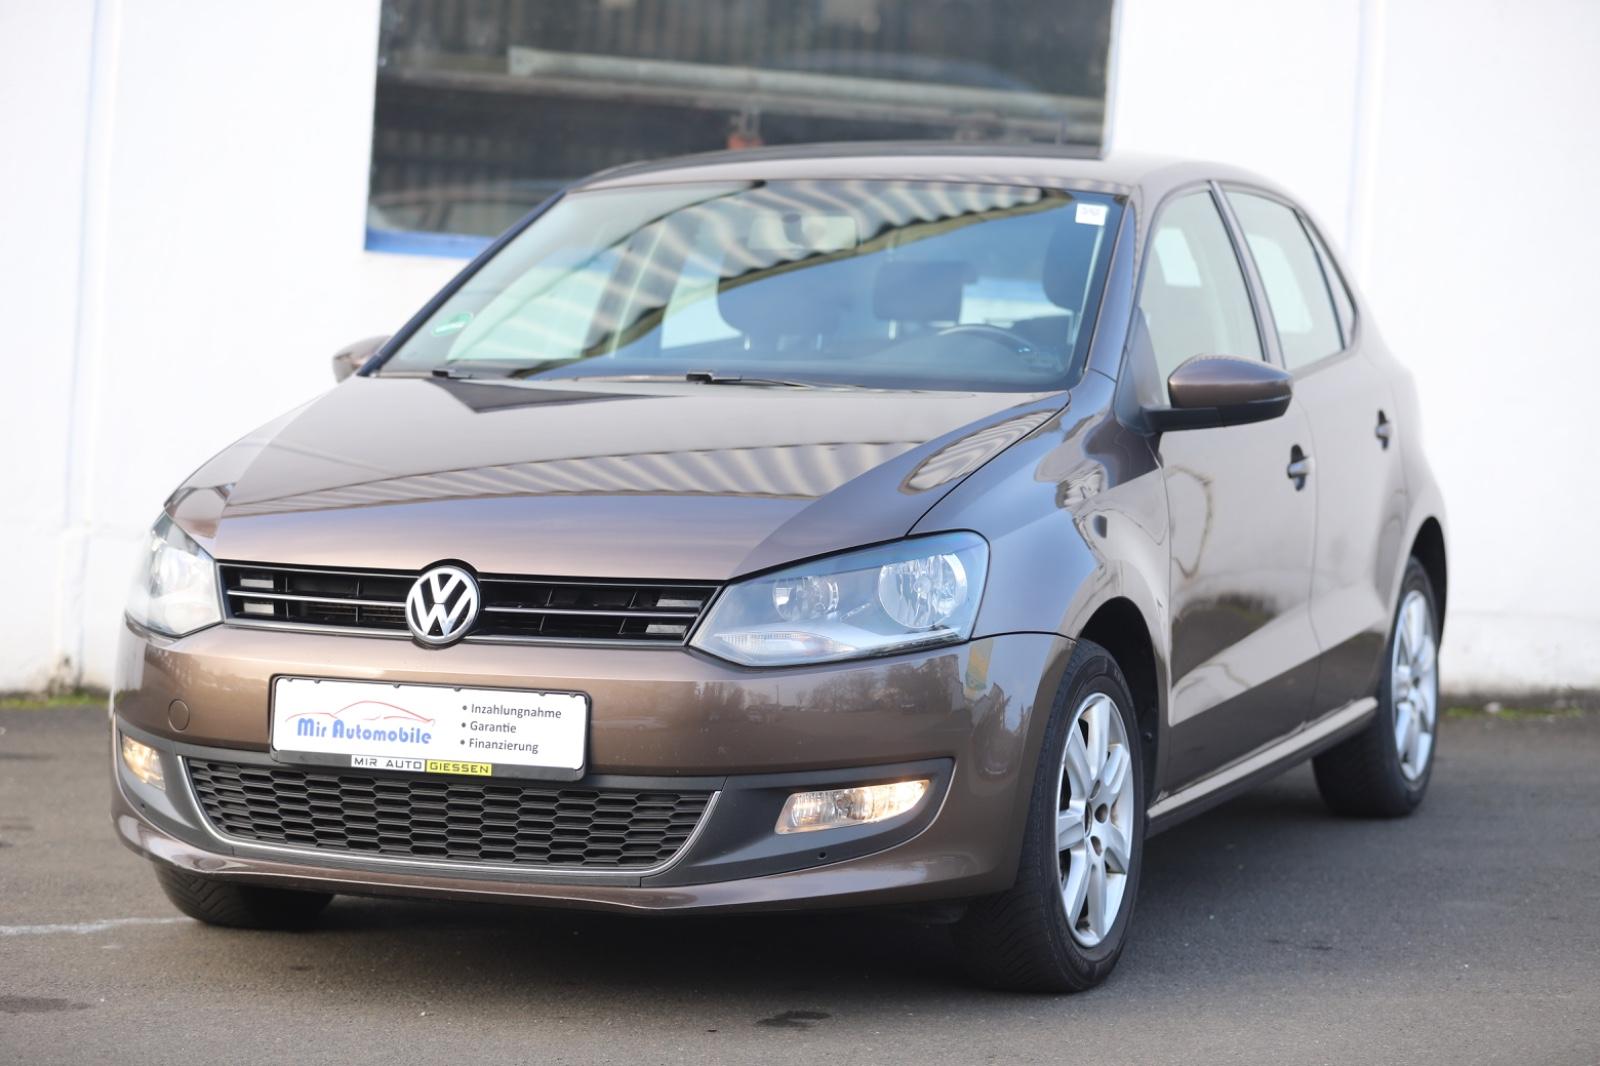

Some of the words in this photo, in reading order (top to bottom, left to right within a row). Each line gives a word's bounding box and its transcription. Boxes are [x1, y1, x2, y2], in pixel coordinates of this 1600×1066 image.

[471, 702, 562, 720] Inzahlungnahme
[296, 716, 326, 739] Mir
[332, 718, 432, 745] Automobile
[470, 720, 517, 735] Garantie
[469, 737, 539, 755] Finanzierung
[354, 757, 378, 768] MIR
[386, 758, 423, 770] AUTO
[429, 761, 490, 775] GIESSEN
